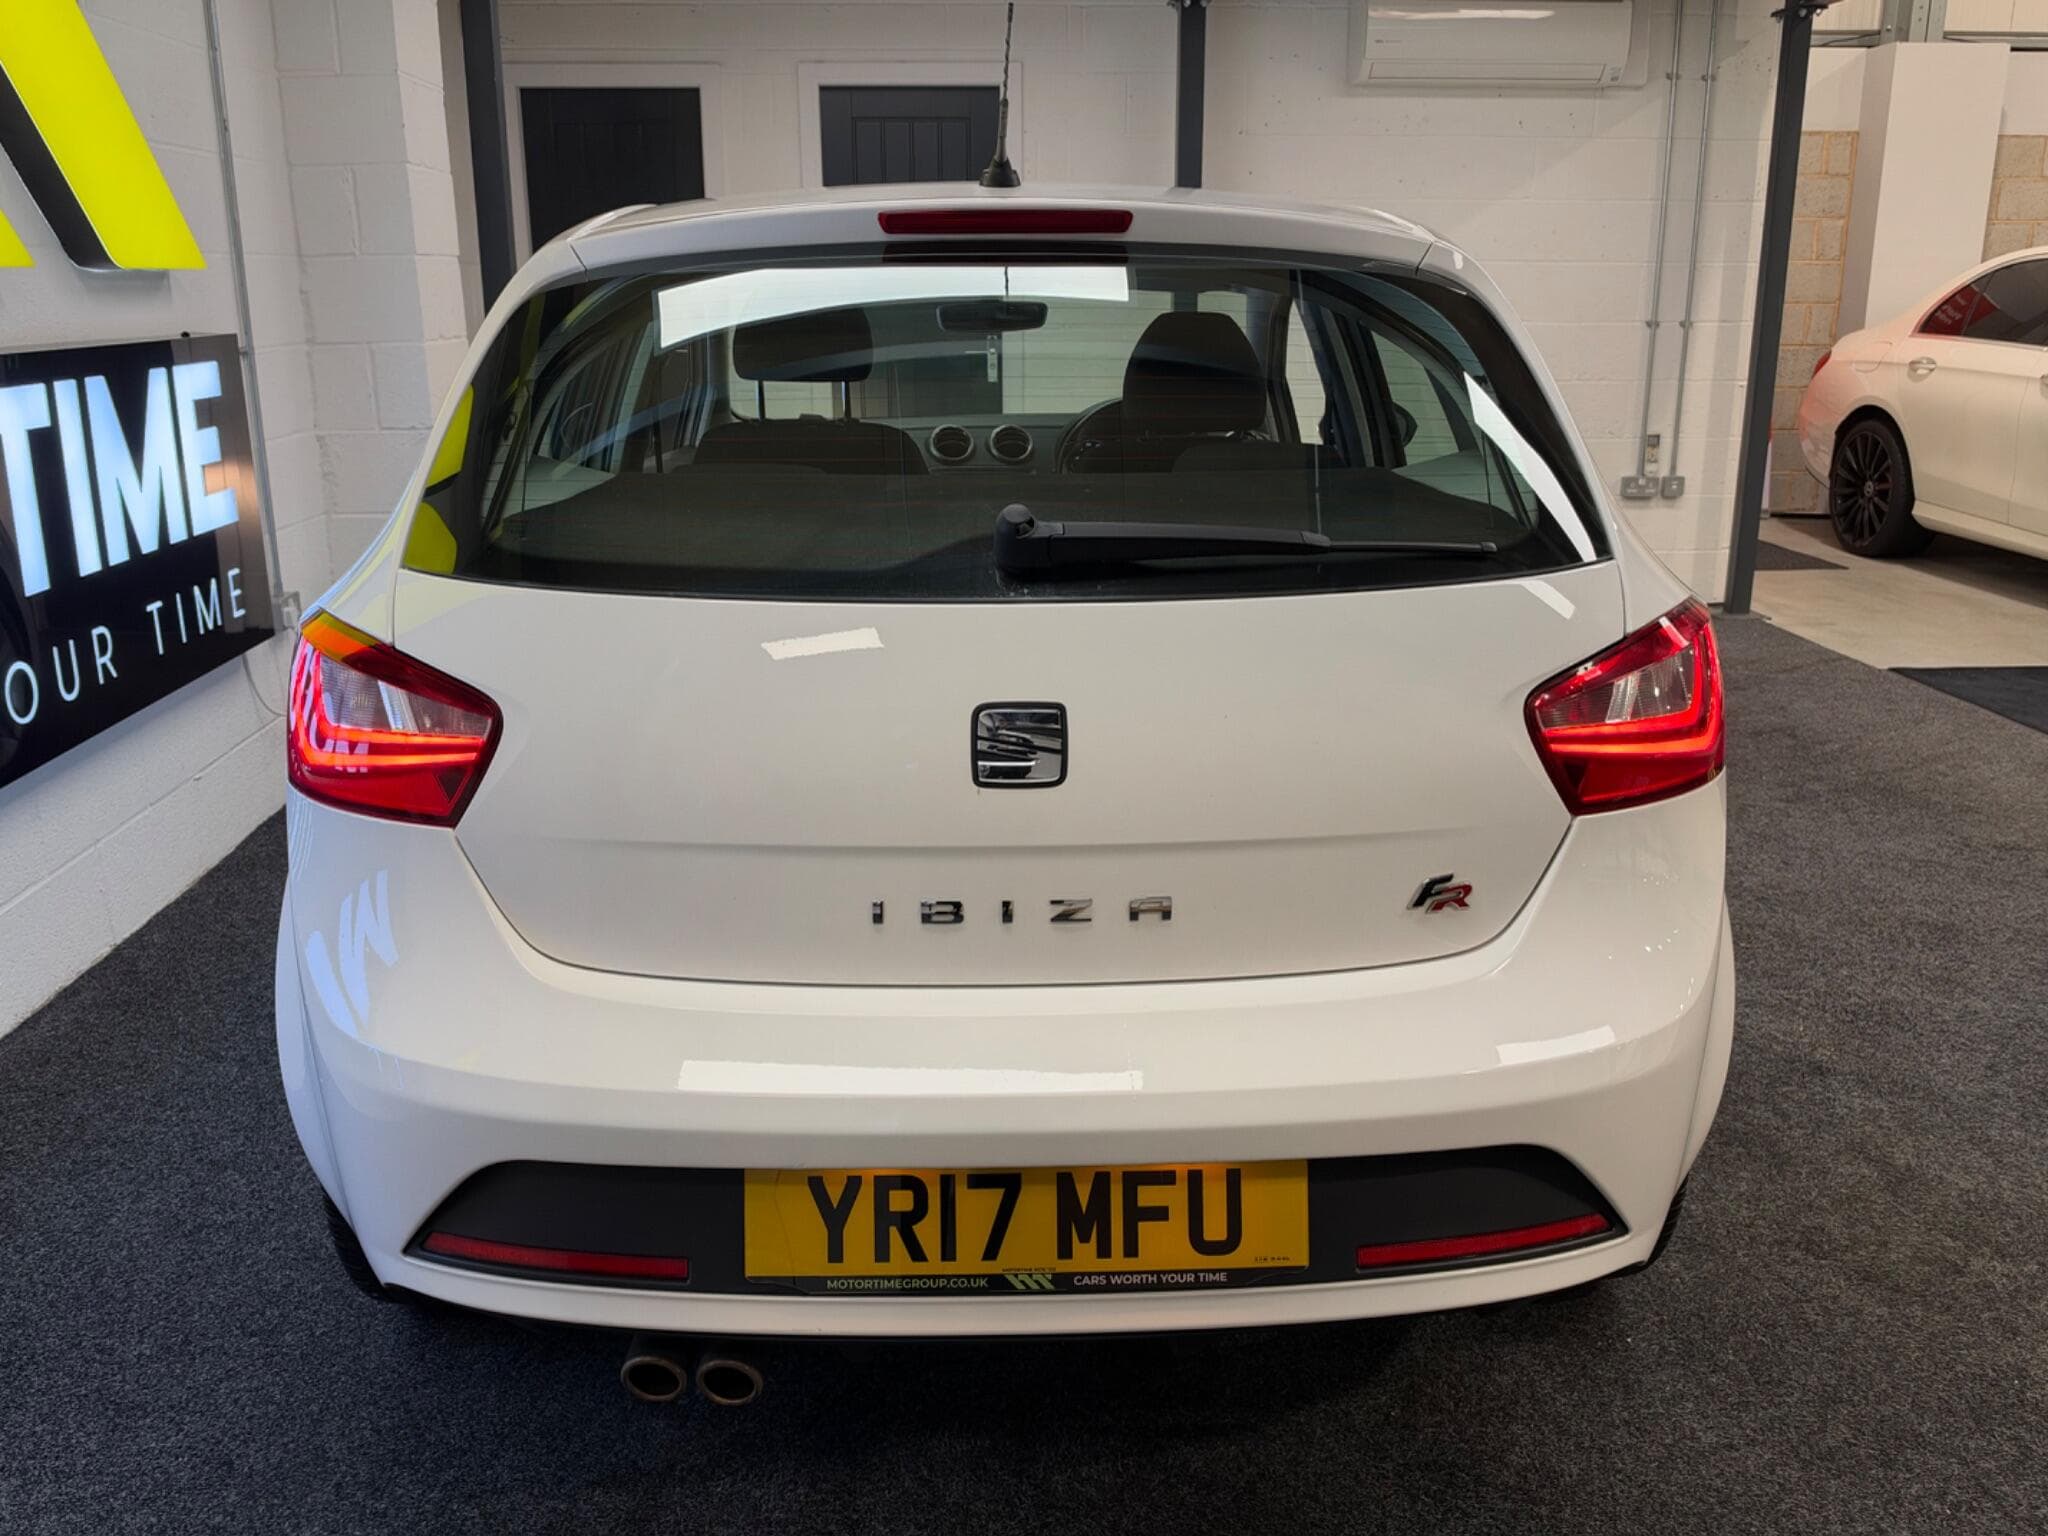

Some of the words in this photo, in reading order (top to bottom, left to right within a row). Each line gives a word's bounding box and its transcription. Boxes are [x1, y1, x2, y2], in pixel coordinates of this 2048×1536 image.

[0, 361, 239, 597] TIME
[146, 567, 247, 655] TIME
[872, 896, 1173, 924] IBIZA
[1406, 873, 1473, 914] FR
[807, 1173, 1022, 1263] YR17
[1056, 1167, 1242, 1261] MFU
[826, 1277, 988, 1290] MOTORTIMEGROUP.CO.UK
[1073, 1275, 1108, 1286] CARS
[1110, 1273, 1157, 1286] WORTH
[1160, 1273, 1197, 1284] YOUR
[1199, 1272, 1227, 1283] TIME
